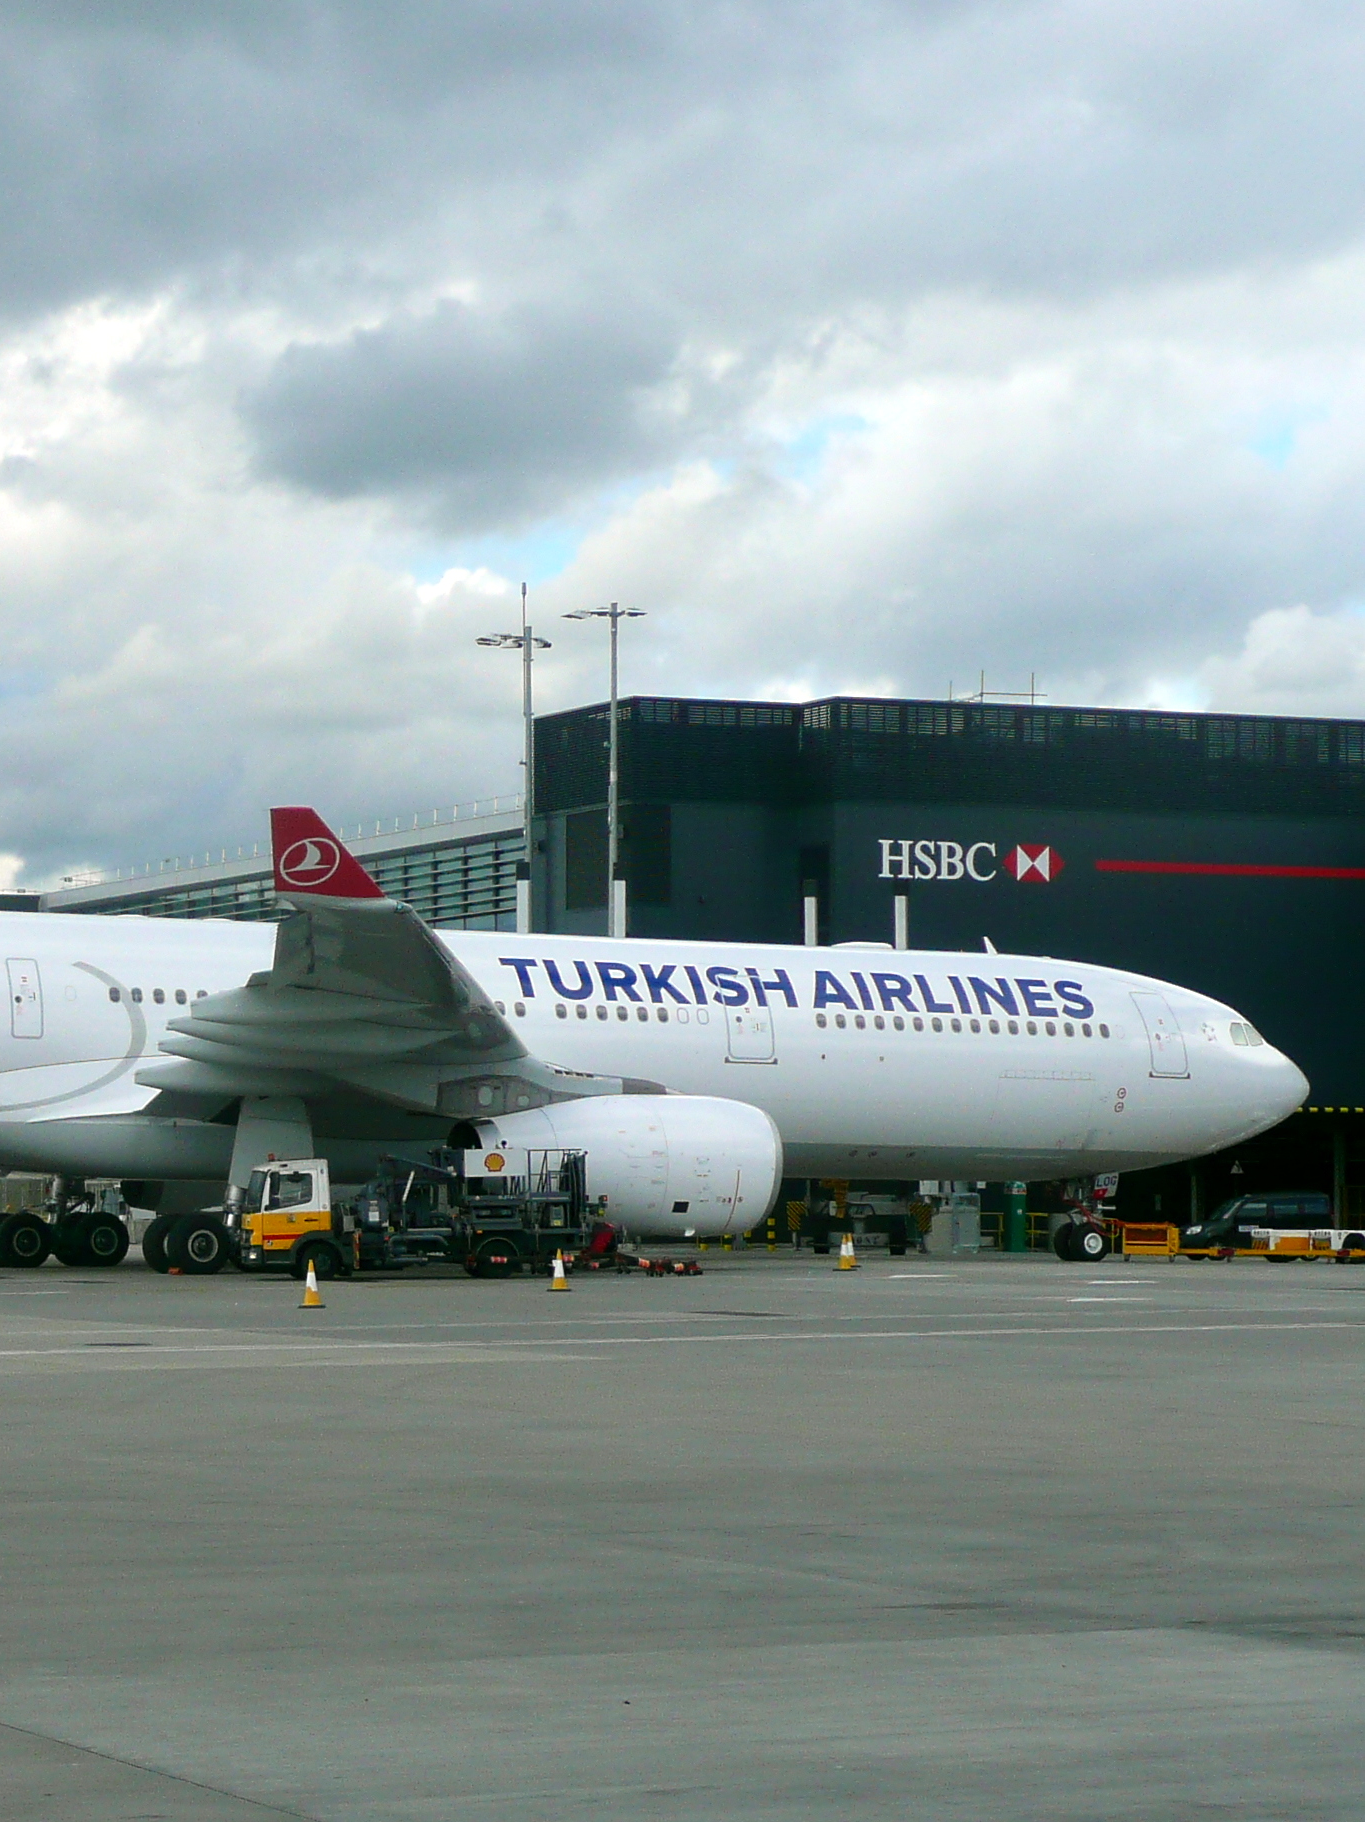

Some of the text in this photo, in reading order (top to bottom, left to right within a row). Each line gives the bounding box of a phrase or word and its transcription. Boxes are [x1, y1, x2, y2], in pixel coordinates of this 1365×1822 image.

[878, 839, 998, 882] HSBC
[500, 957, 1094, 1018] TURKISH AIRLINES
[1096, 1176, 1117, 1187] LOG
